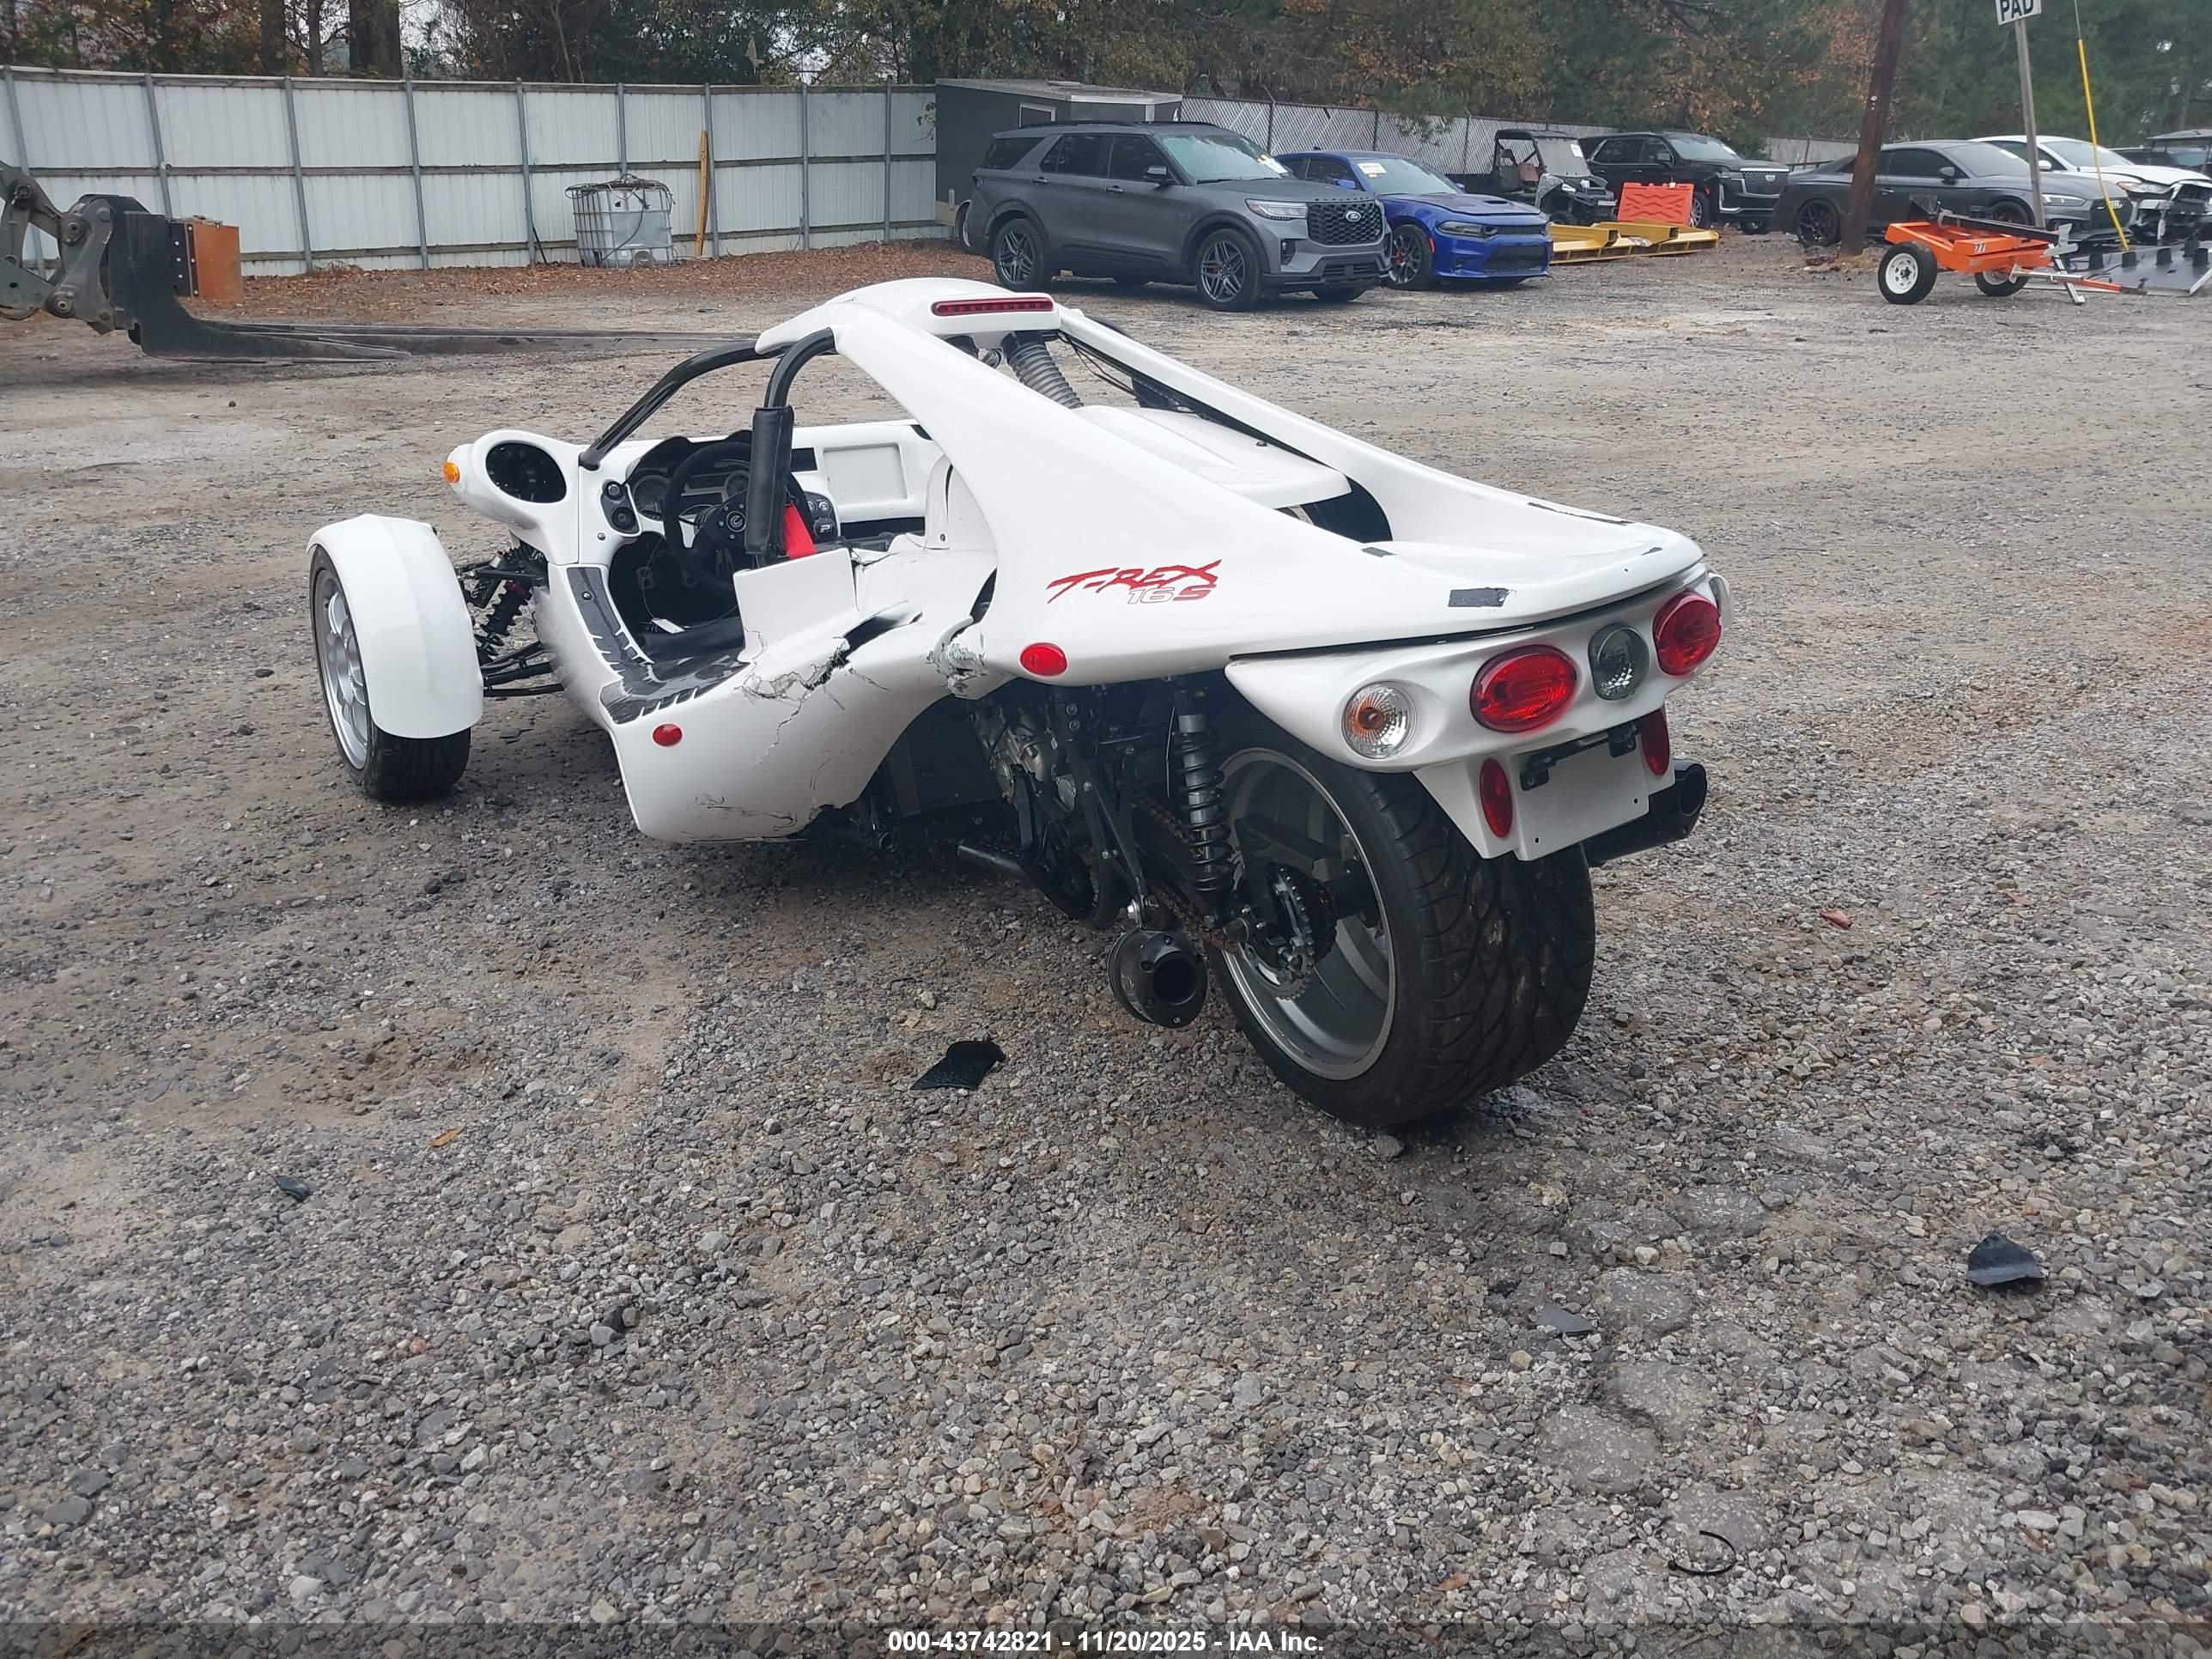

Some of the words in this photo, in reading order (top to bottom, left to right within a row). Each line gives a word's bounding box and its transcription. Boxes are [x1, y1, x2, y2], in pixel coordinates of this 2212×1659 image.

[1999, 0, 2034, 21] PAD
[1046, 559, 1222, 604] T-REX
[1127, 584, 1217, 605] 16S
